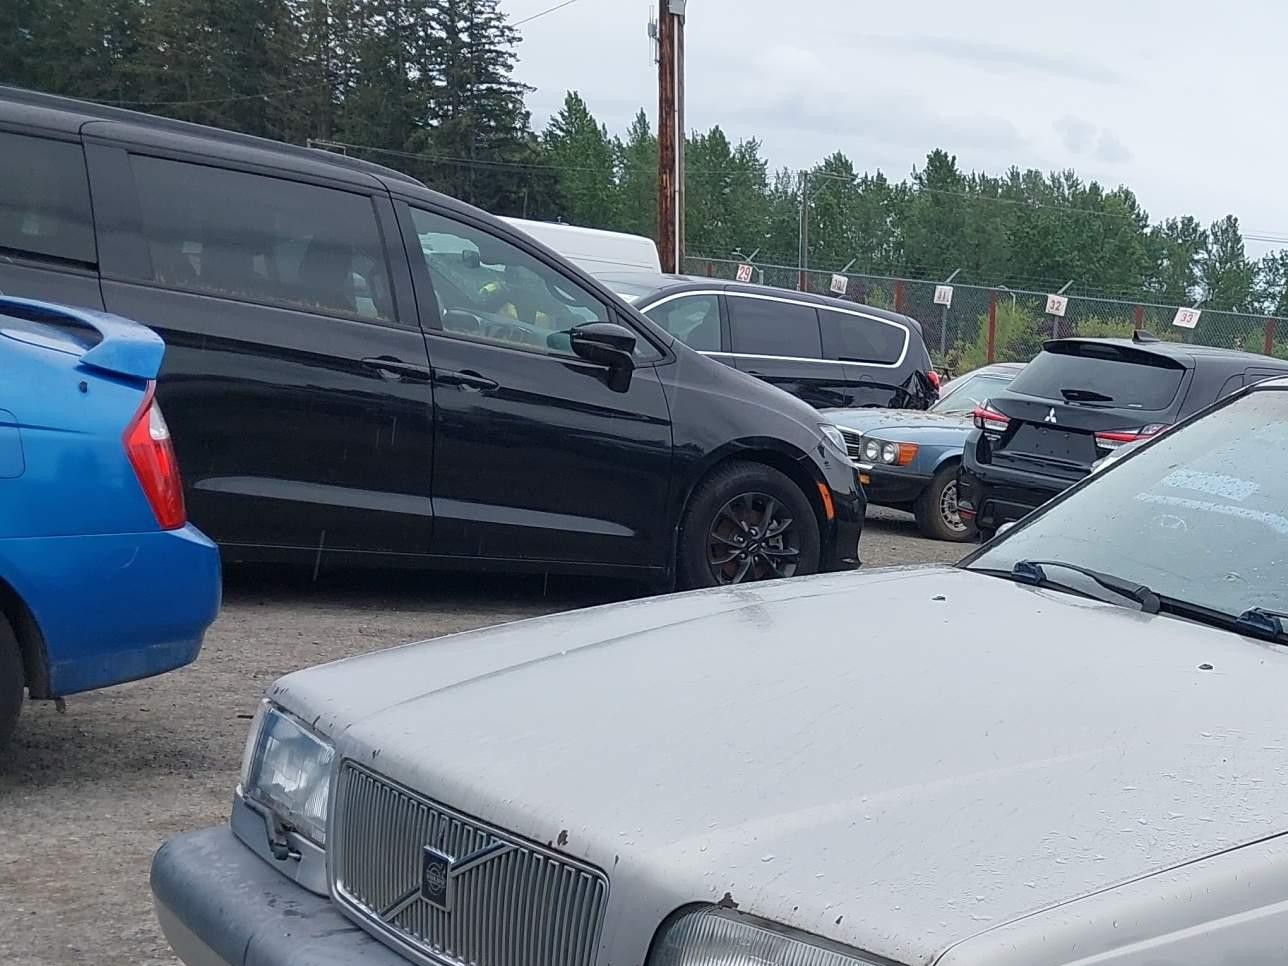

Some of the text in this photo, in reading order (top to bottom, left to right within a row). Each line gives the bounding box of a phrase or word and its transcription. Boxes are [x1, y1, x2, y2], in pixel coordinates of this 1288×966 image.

[738, 265, 752, 280] 29
[1049, 300, 1062, 311] 32
[1180, 312, 1194, 323] 33
